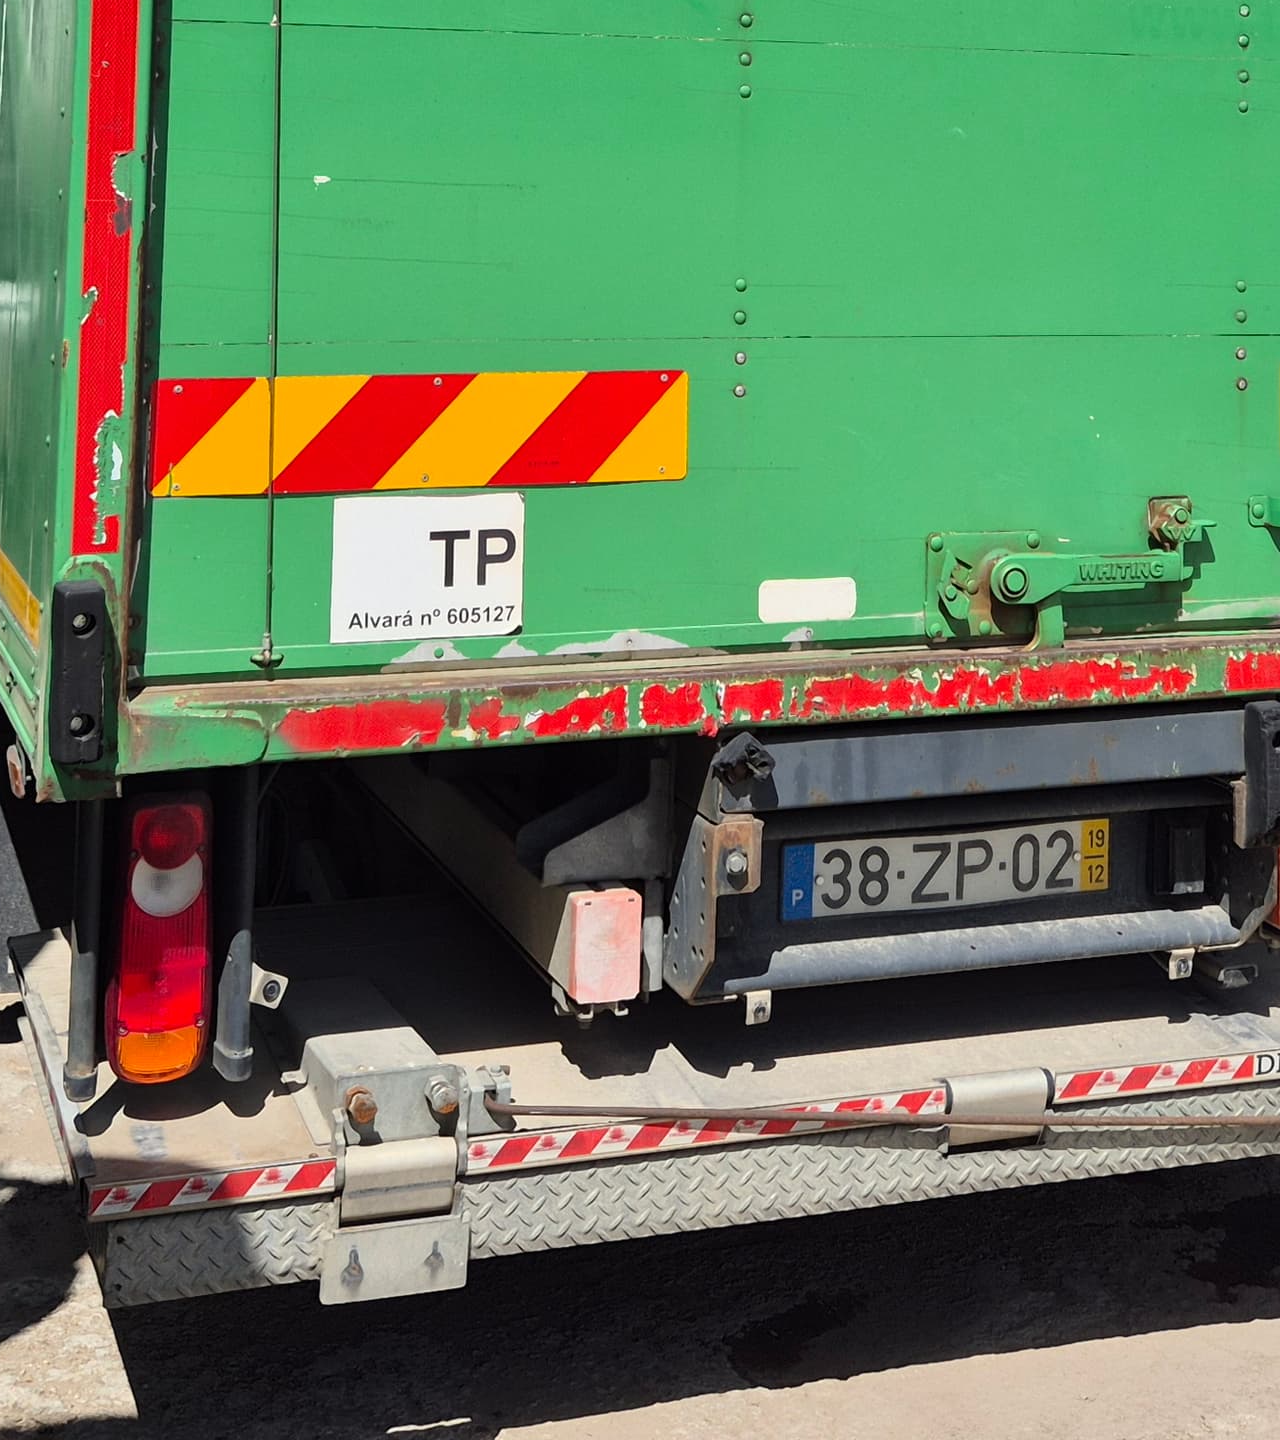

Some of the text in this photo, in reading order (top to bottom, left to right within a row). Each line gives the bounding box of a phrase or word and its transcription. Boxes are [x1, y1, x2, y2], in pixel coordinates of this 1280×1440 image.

[429, 528, 517, 587] TP
[1078, 560, 1166, 583] WHITING
[348, 605, 516, 630] Alvará nº 605127
[1087, 829, 1105, 848] 19
[1086, 864, 1105, 884] 12
[792, 889, 803, 905] P
